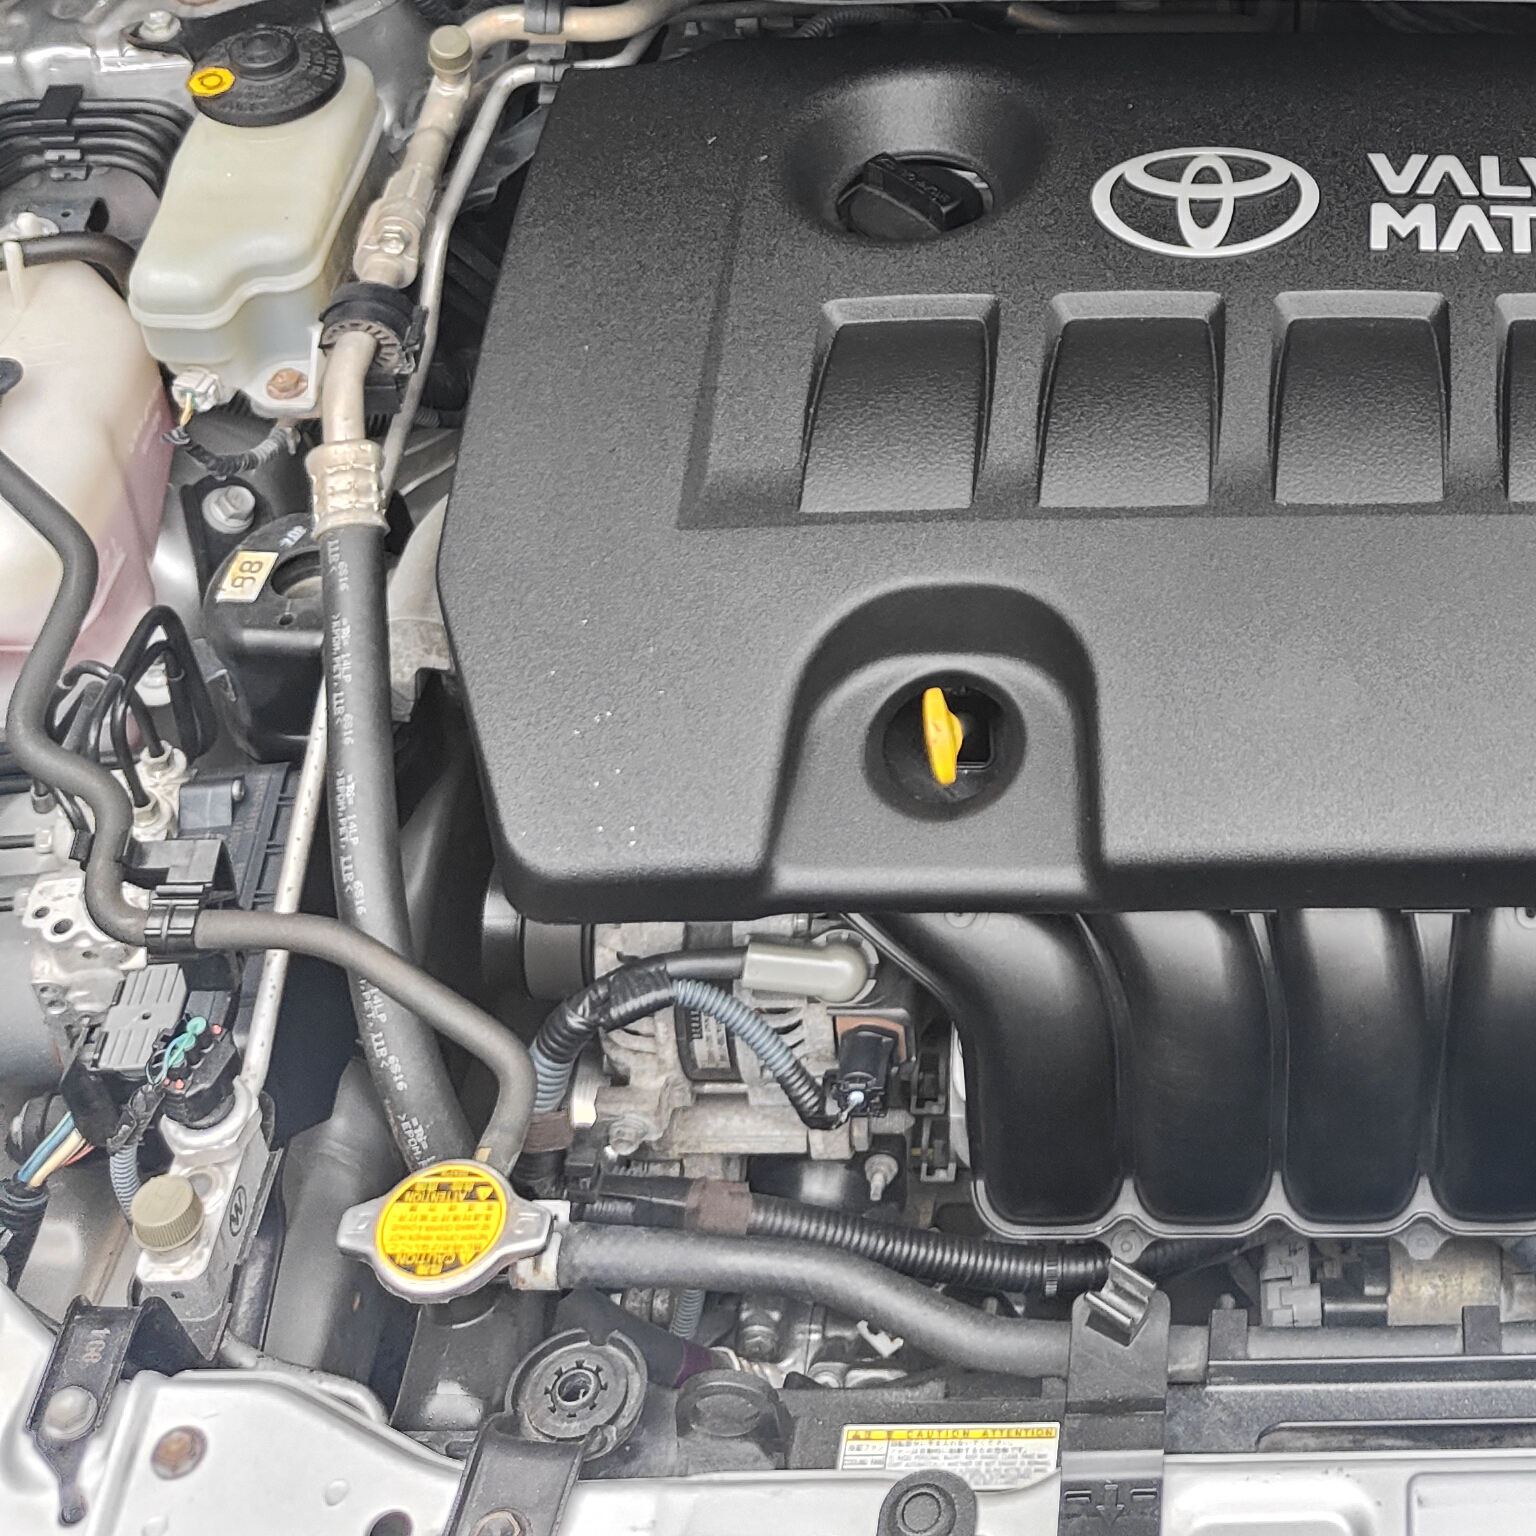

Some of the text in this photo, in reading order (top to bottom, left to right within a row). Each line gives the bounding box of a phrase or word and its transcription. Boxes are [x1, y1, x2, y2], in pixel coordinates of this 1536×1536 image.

[403, 1190, 468, 1202] ATTENTION
[395, 1252, 457, 1265] CAUTION
[907, 1427, 1054, 1439] CAUTION ATTENTION
